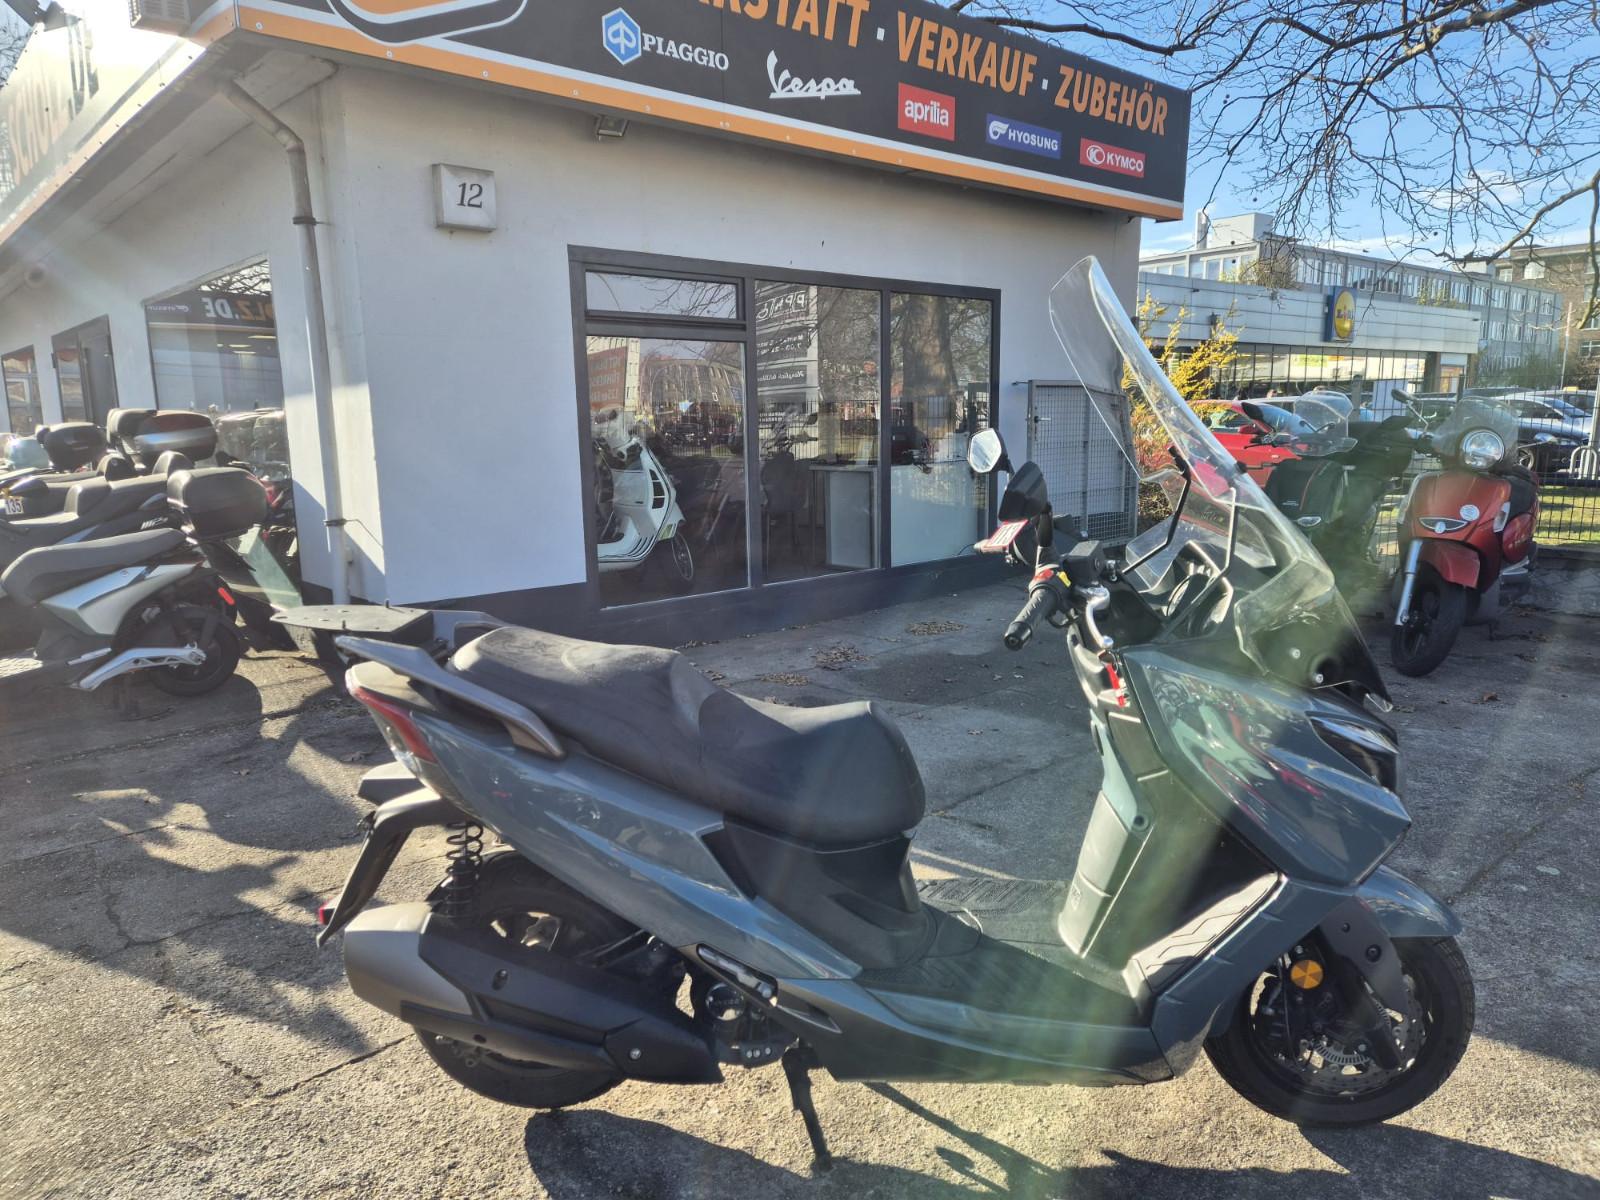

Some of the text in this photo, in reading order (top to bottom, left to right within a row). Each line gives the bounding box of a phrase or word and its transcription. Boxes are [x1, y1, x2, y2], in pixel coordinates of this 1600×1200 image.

[642, 32, 729, 70] PIAGGIO
[766, 49, 861, 100] Vespa
[897, 11, 1038, 97] VERKAUF
[1054, 64, 1169, 136] ZUBEHÖR
[904, 100, 949, 128] aprilia
[1008, 128, 1058, 151] HYOSUNG
[1106, 152, 1144, 173] KYMCO
[456, 182, 483, 209] 12
